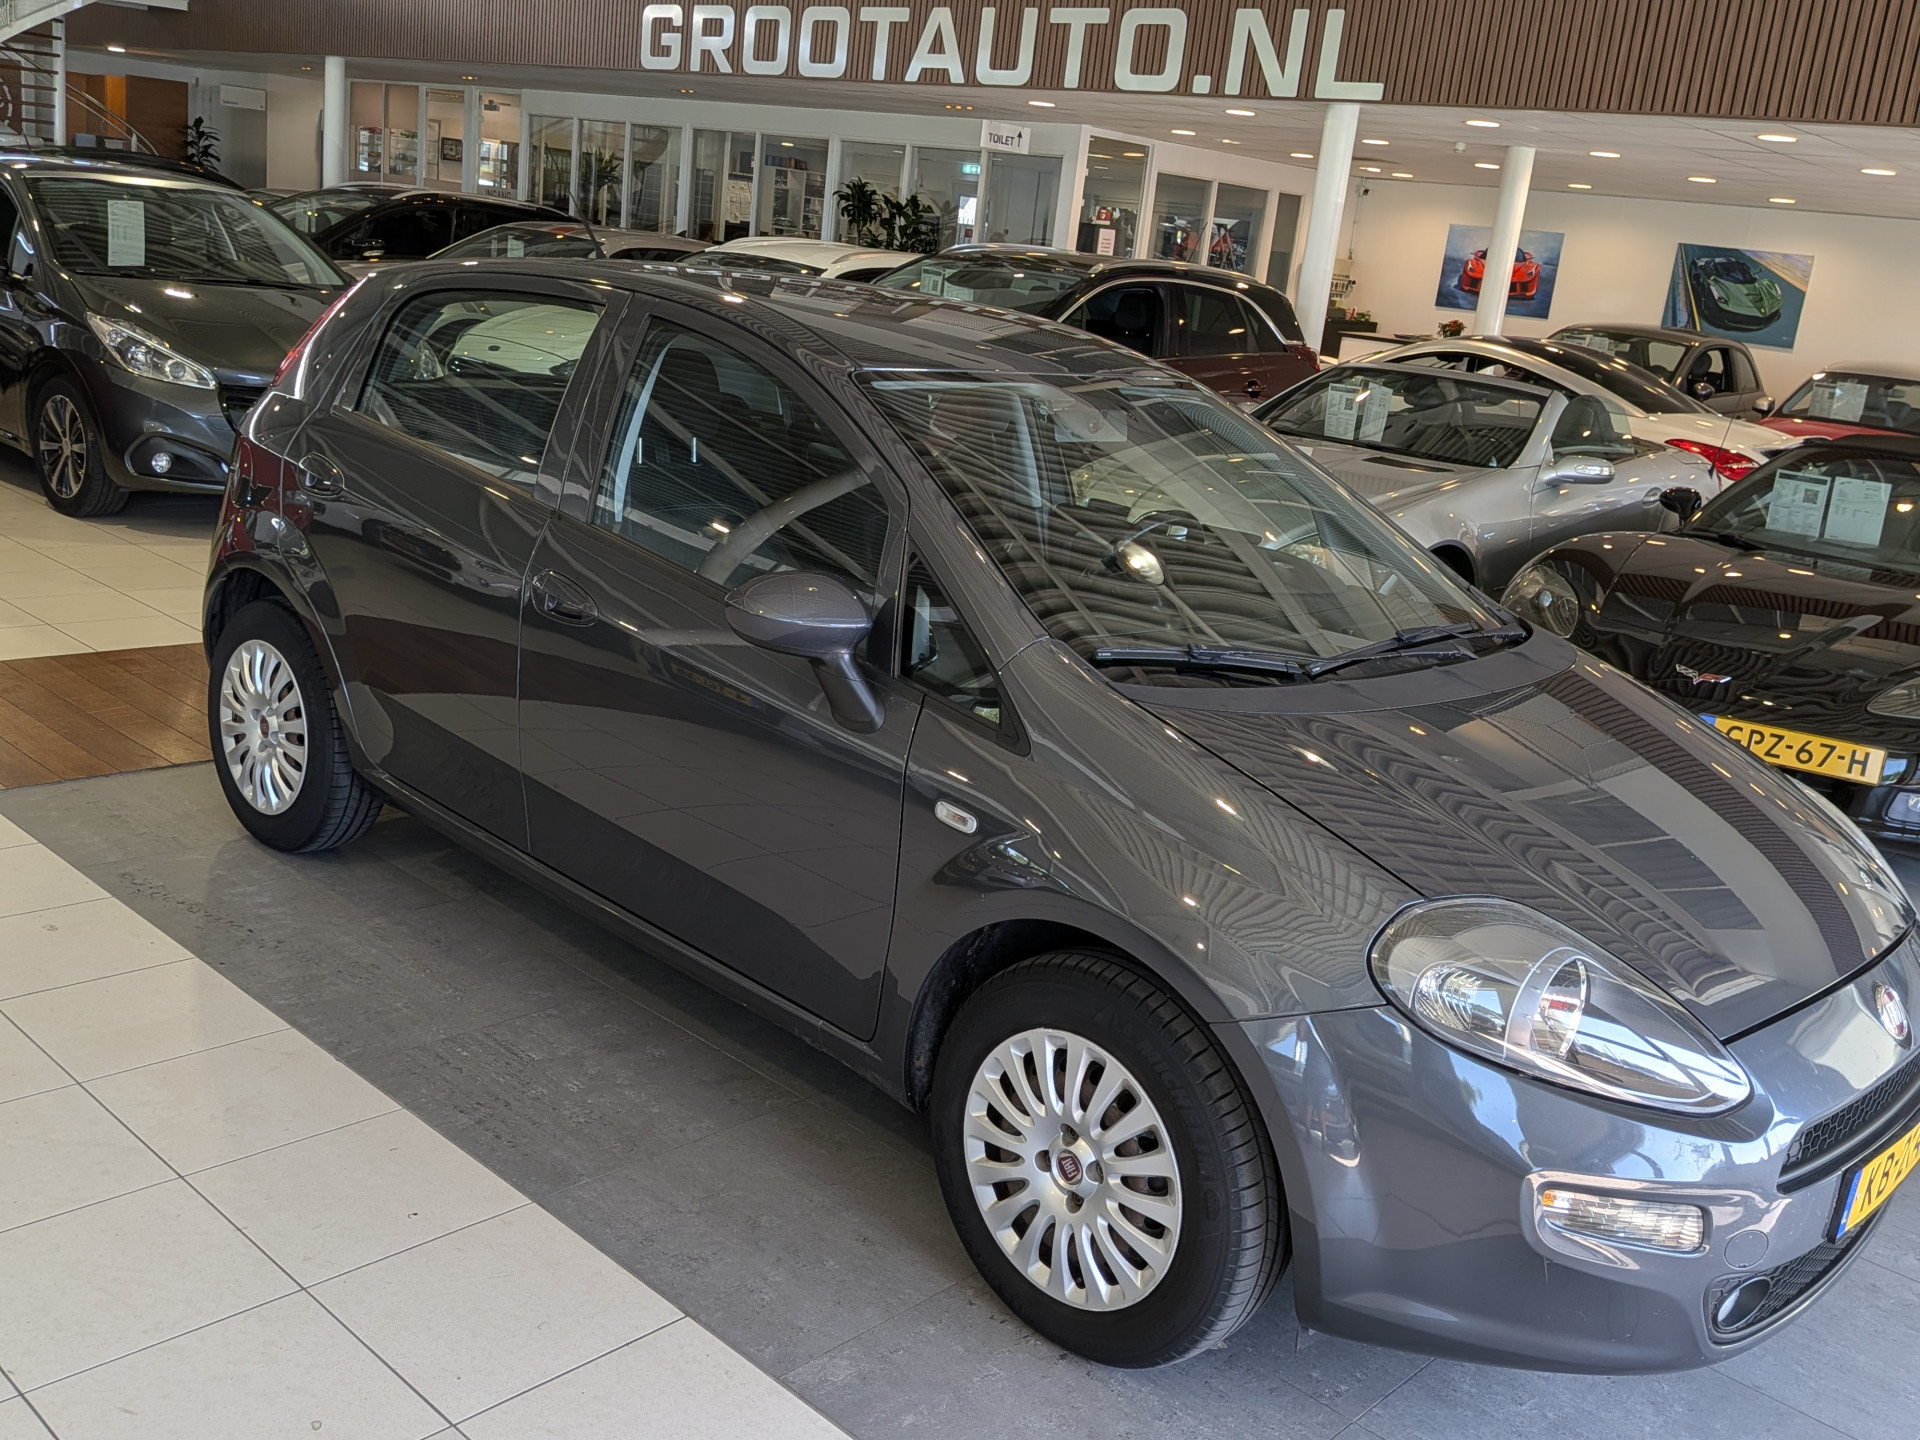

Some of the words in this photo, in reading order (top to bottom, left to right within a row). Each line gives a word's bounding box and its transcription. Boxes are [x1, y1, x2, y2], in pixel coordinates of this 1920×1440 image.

[640, 4, 1384, 101] GROOTAUTO.NL
[988, 132, 1015, 147] TOILET
[1061, 1156, 1079, 1179] FIAT
